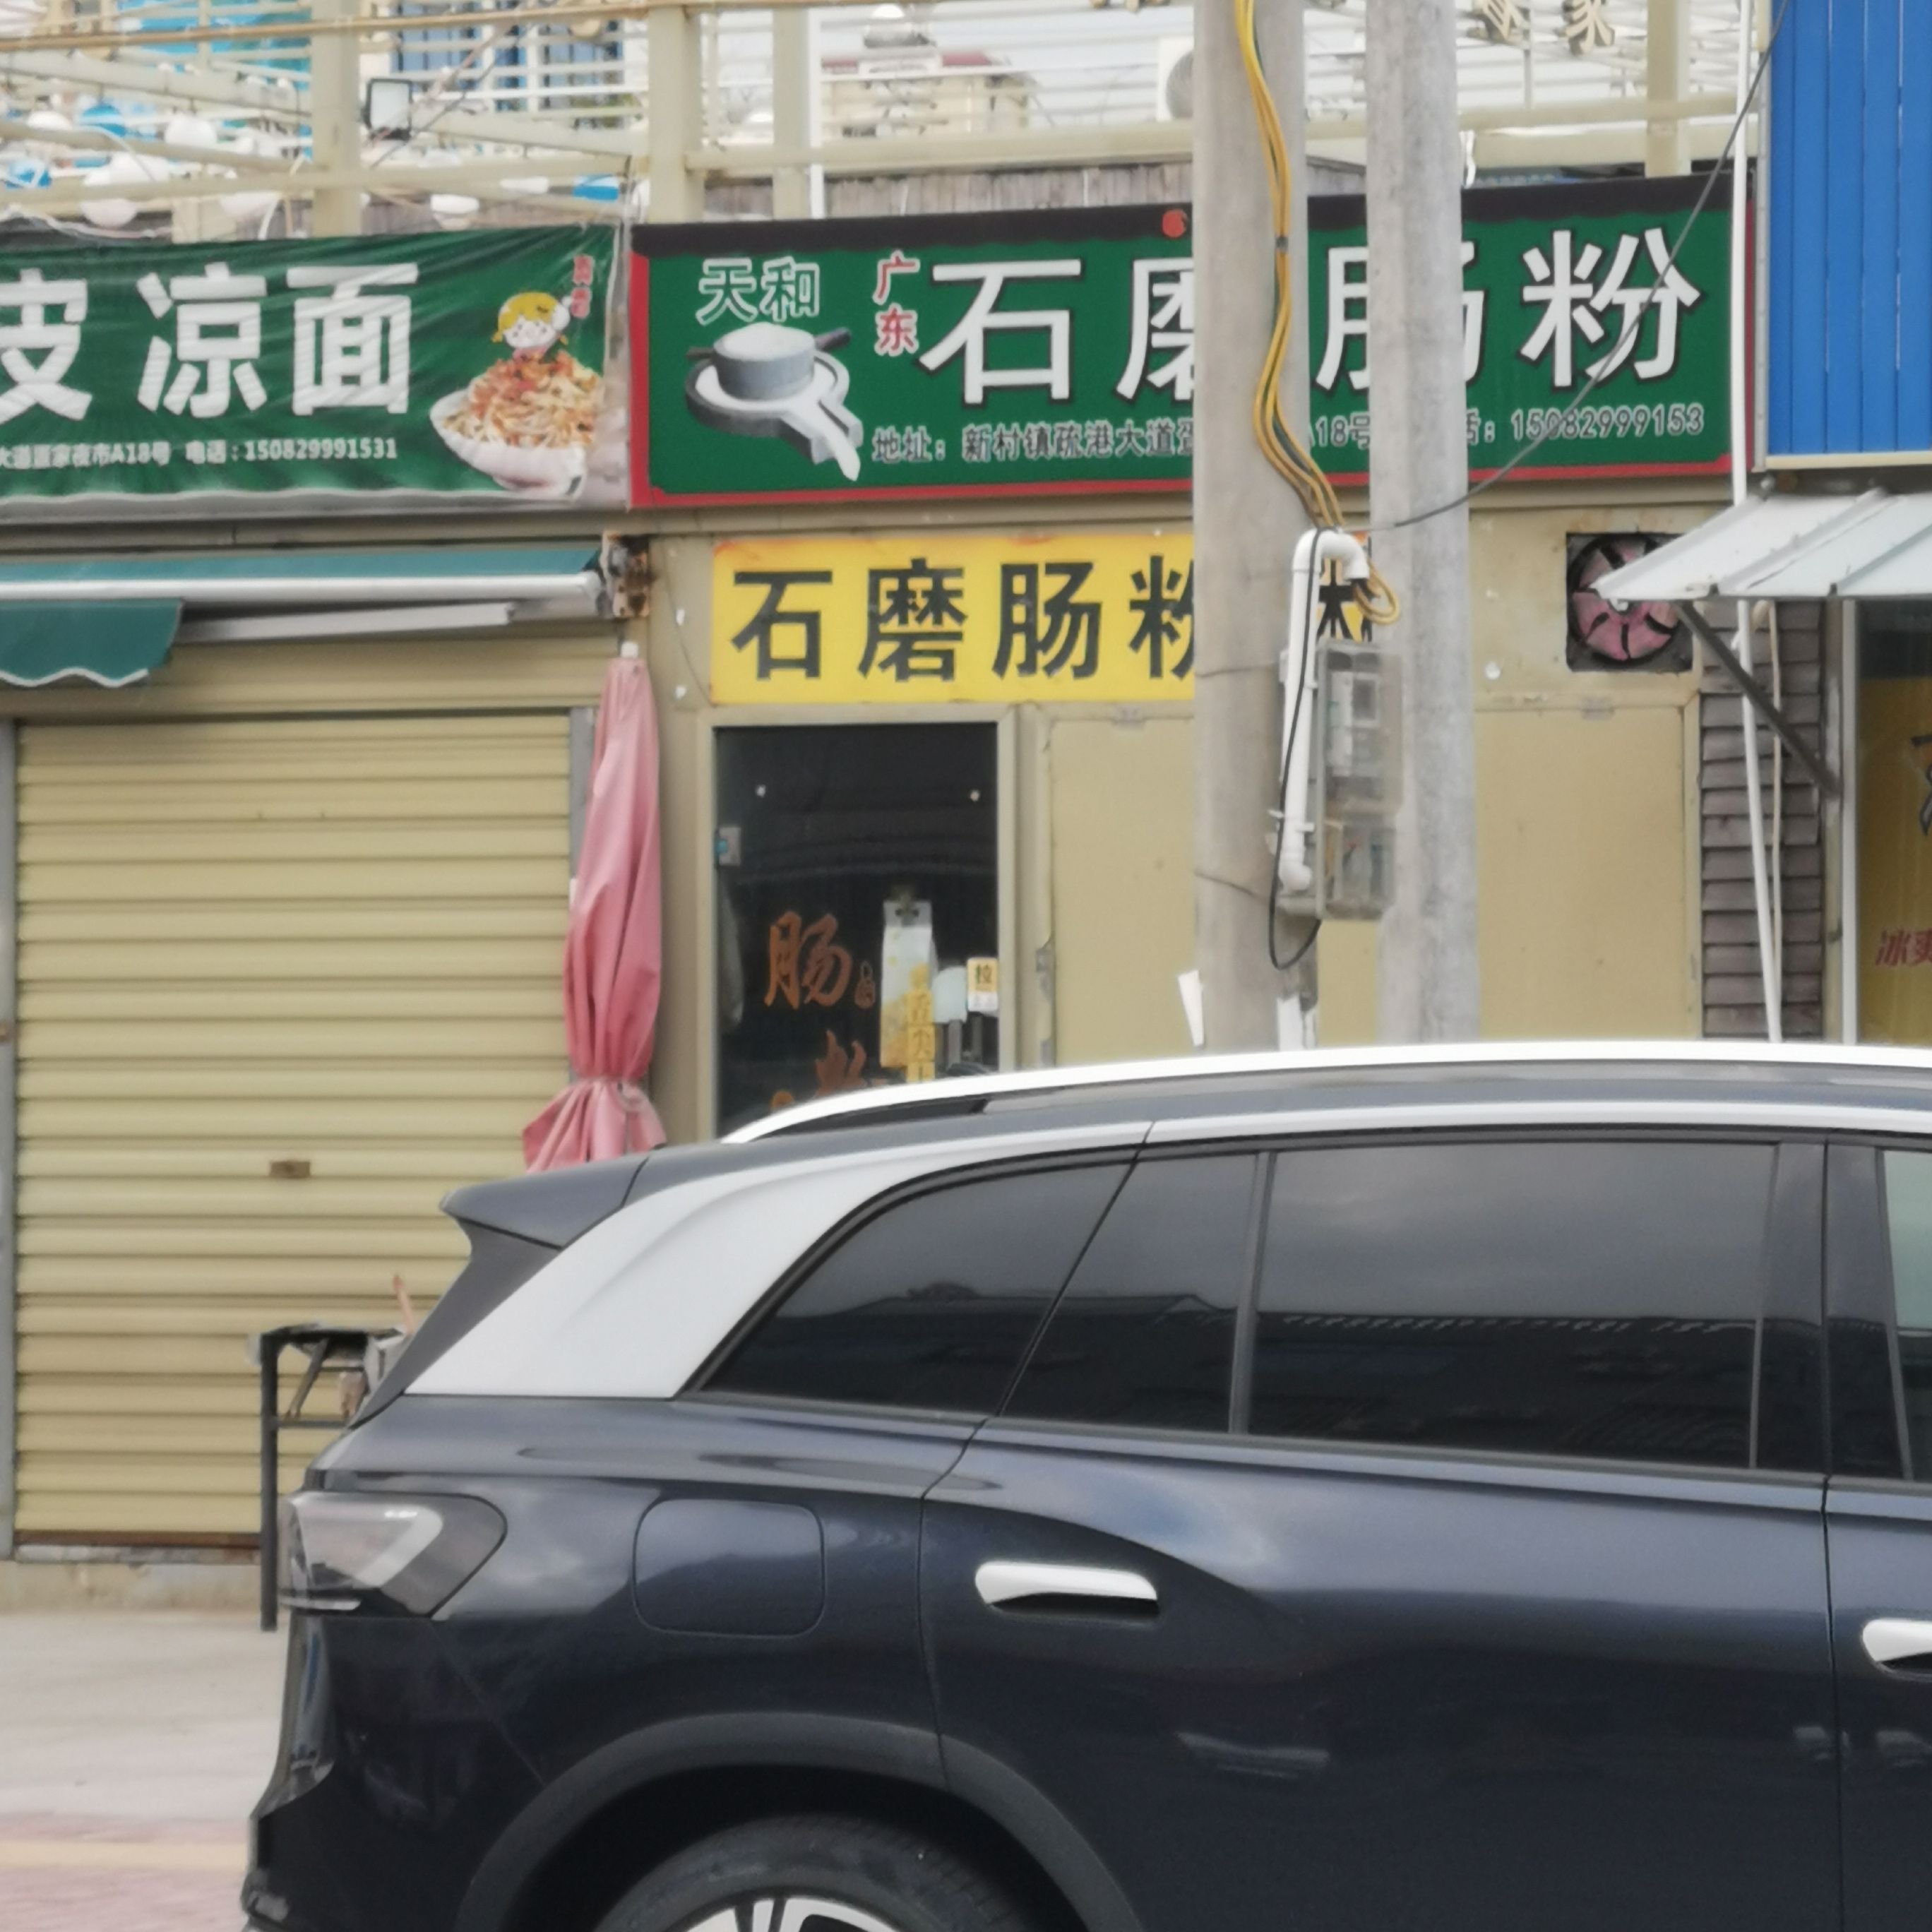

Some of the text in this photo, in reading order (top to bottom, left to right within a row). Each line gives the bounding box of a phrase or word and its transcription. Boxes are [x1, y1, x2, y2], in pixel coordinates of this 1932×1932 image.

[0, 261, 419, 420] 皮凉面
[696, 256, 822, 326] 天和
[871, 249, 920, 358] 广东
[1308, 411, 1370, 450] 18号
[731, 554, 1195, 682] 石磨肠粉
